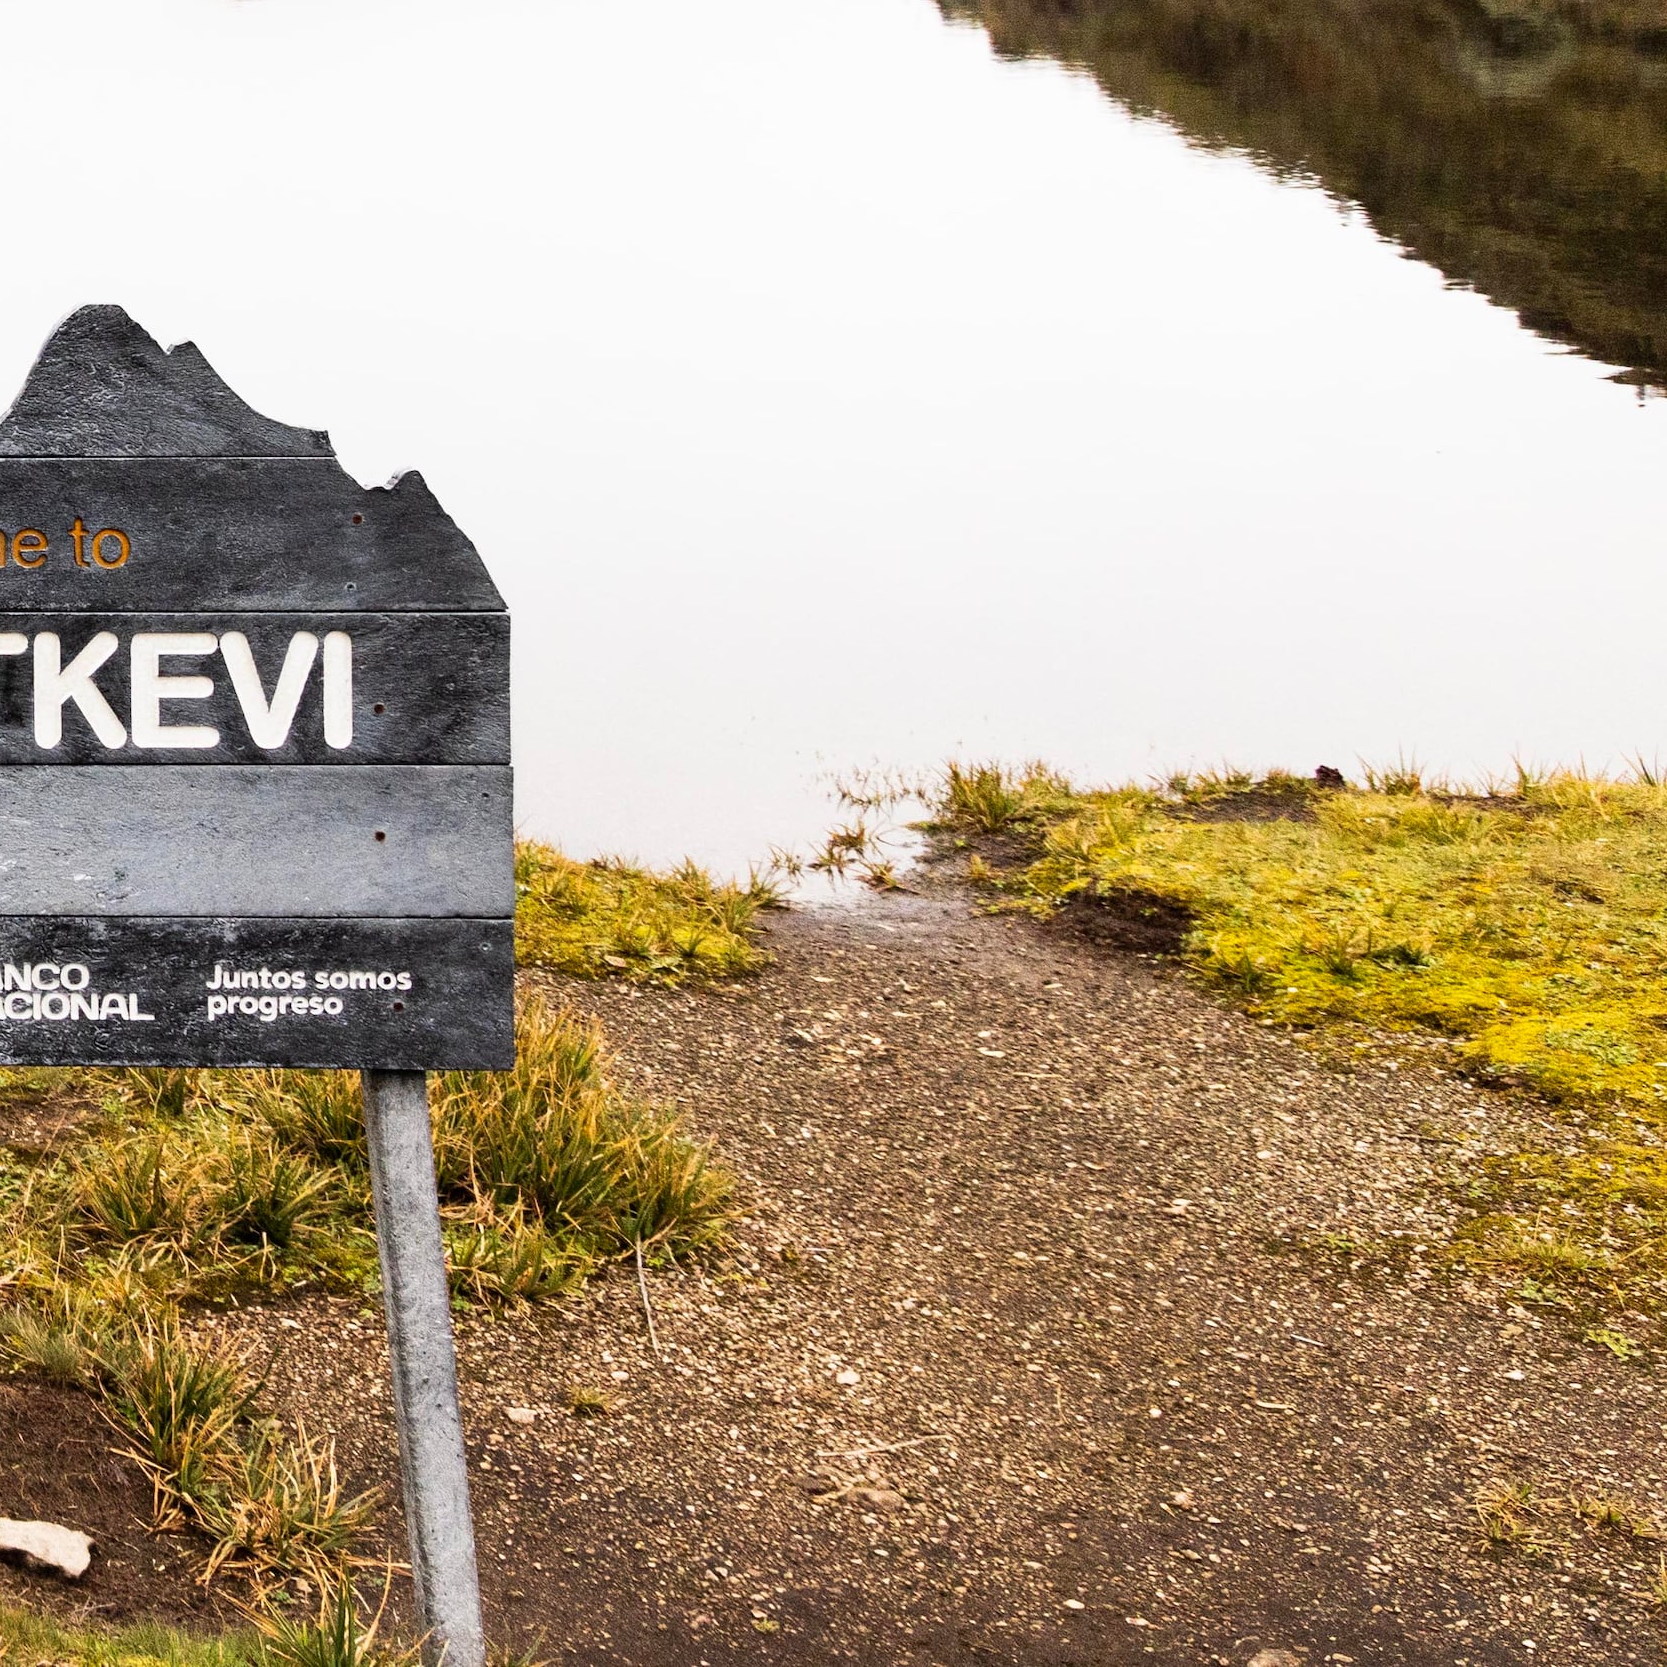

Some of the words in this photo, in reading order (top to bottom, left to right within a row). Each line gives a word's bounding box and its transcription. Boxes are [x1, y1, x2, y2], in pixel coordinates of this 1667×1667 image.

[69, 517, 131, 569] to
[206, 965, 306, 990] Juntos
[315, 970, 412, 990] somos
[207, 994, 343, 1021] progreso
